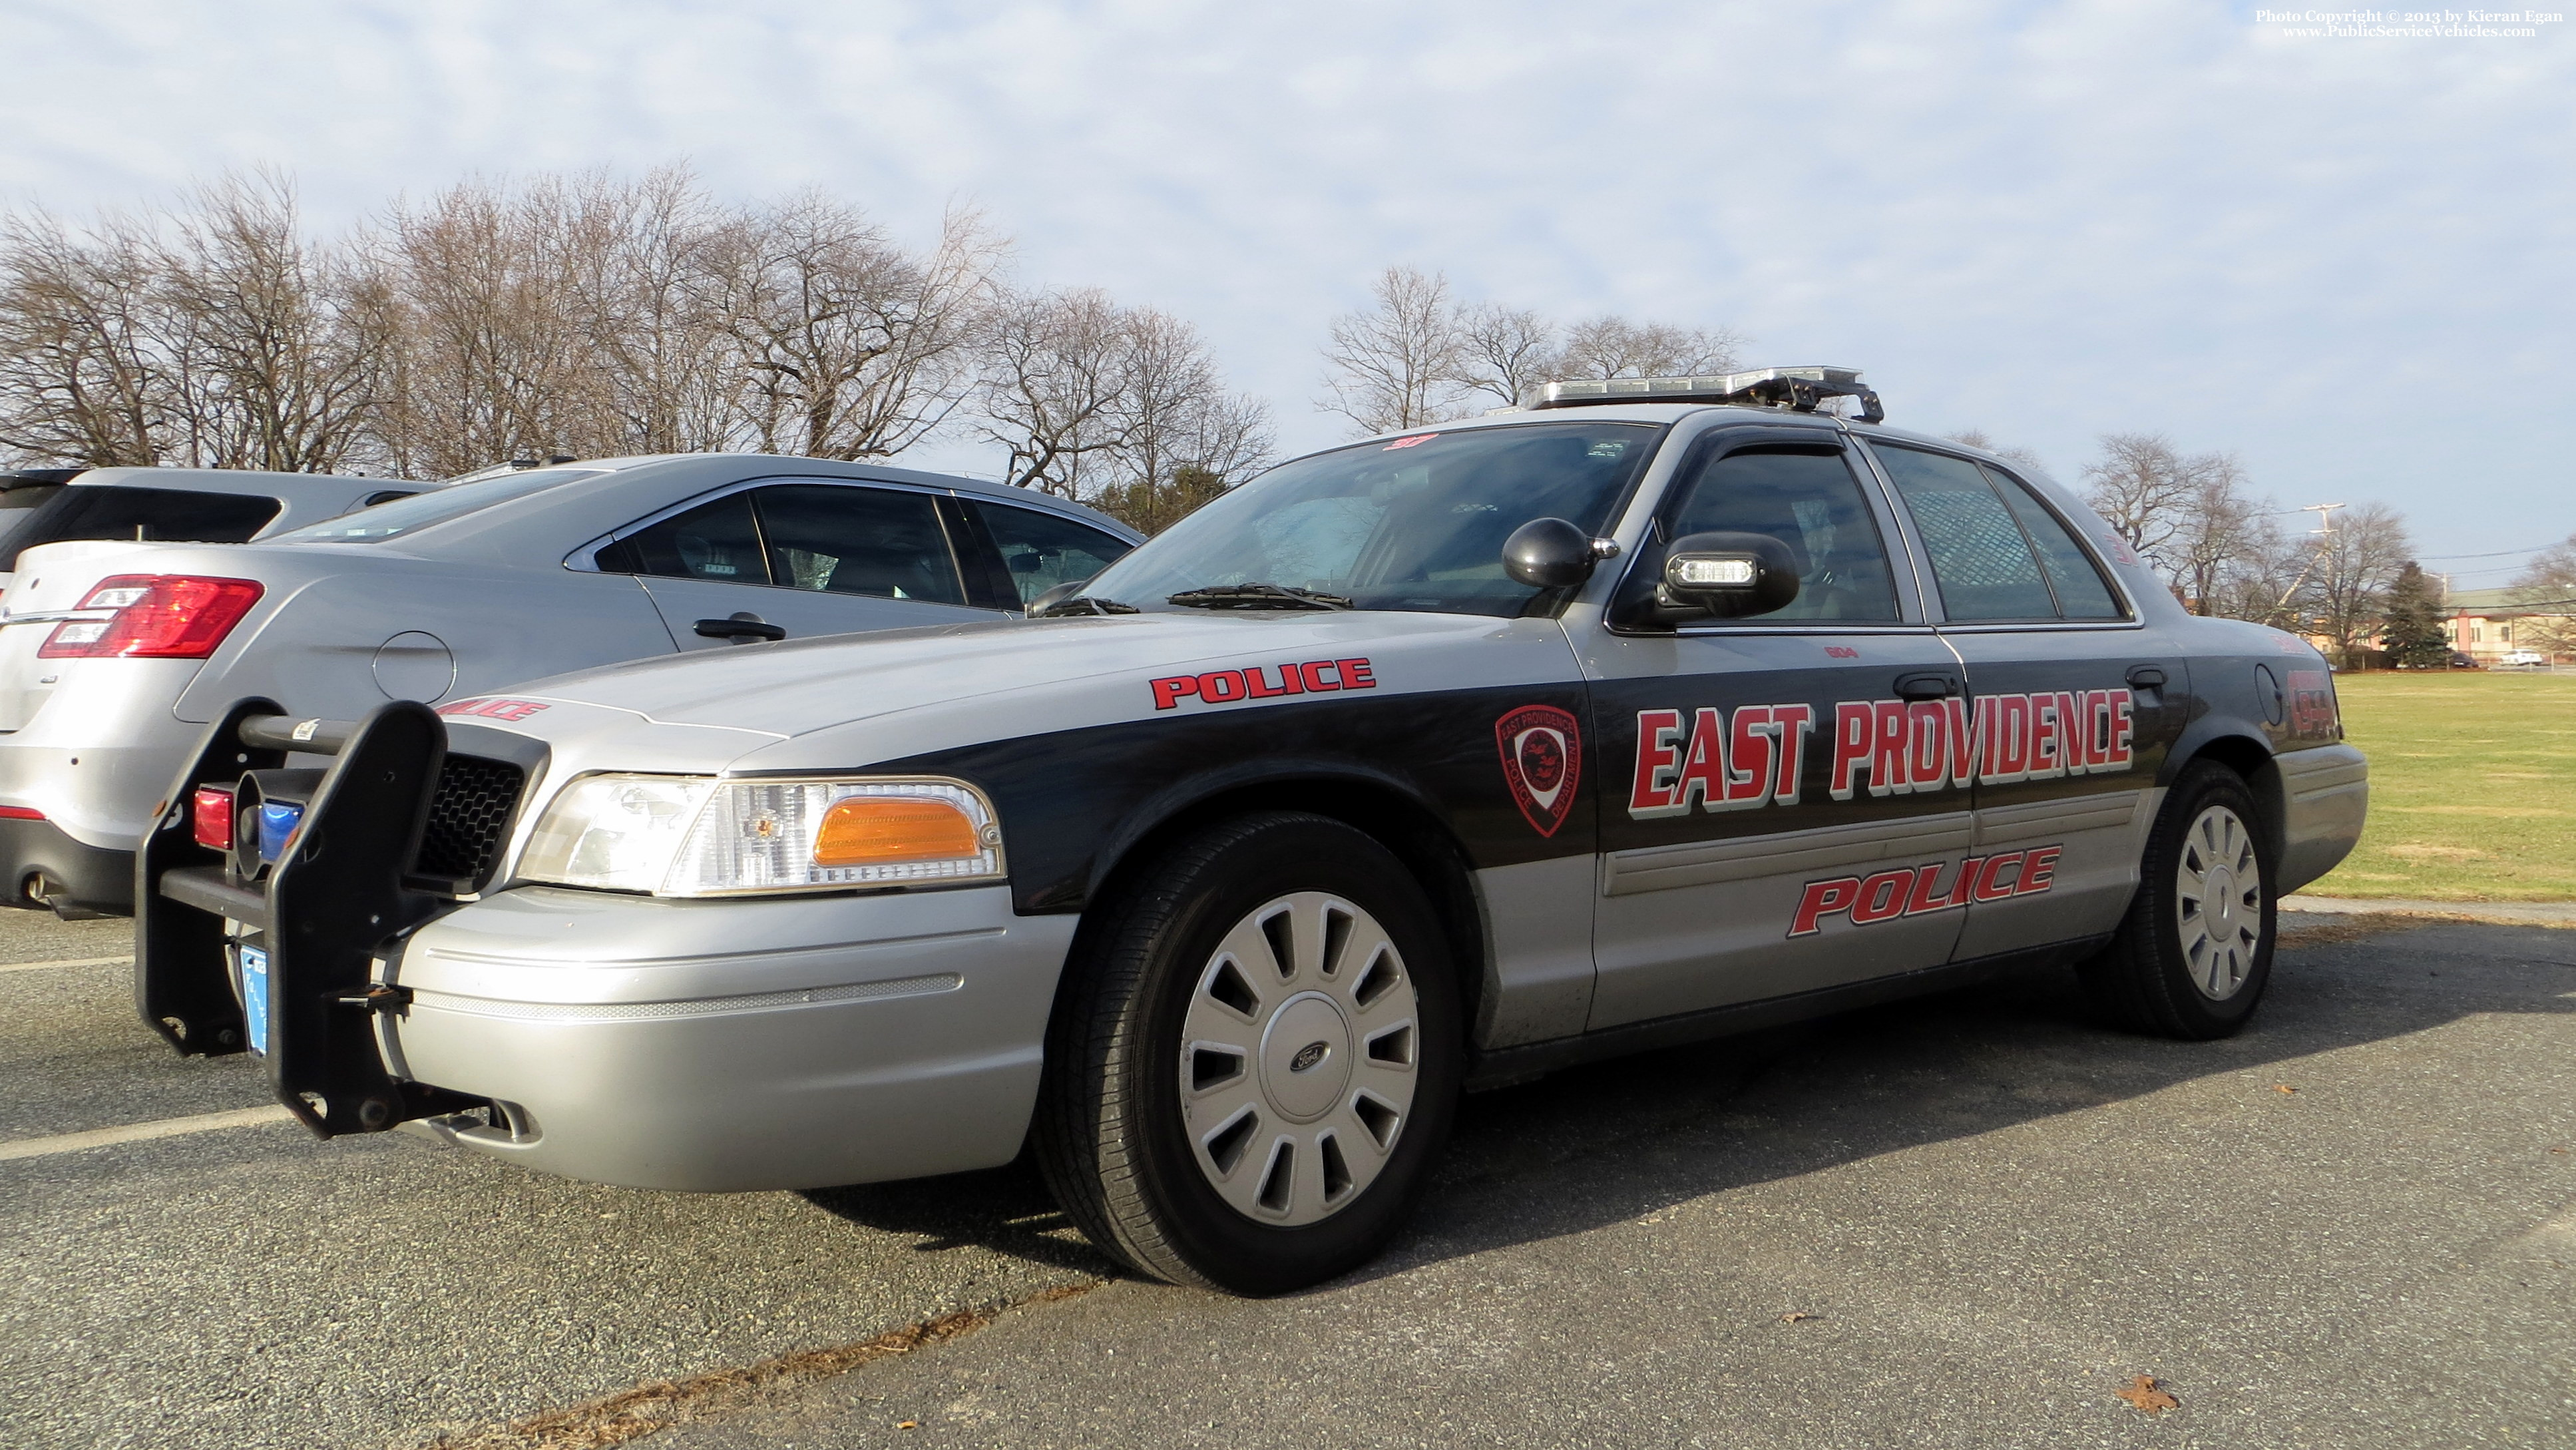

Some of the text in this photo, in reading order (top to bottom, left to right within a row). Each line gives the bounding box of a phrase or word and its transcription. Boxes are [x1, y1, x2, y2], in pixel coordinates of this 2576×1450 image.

[1149, 657, 1377, 710] POLICE
[1501, 712, 1574, 740] EAST PROVIDENCE
[1552, 738, 1577, 818] DEPARTMENT
[1627, 688, 2133, 820] EAST PROVIDENCE
[1506, 758, 1534, 810] POLICE
[1785, 843, 2063, 940] POLICE
[1298, 1049, 1318, 1067] Ford
